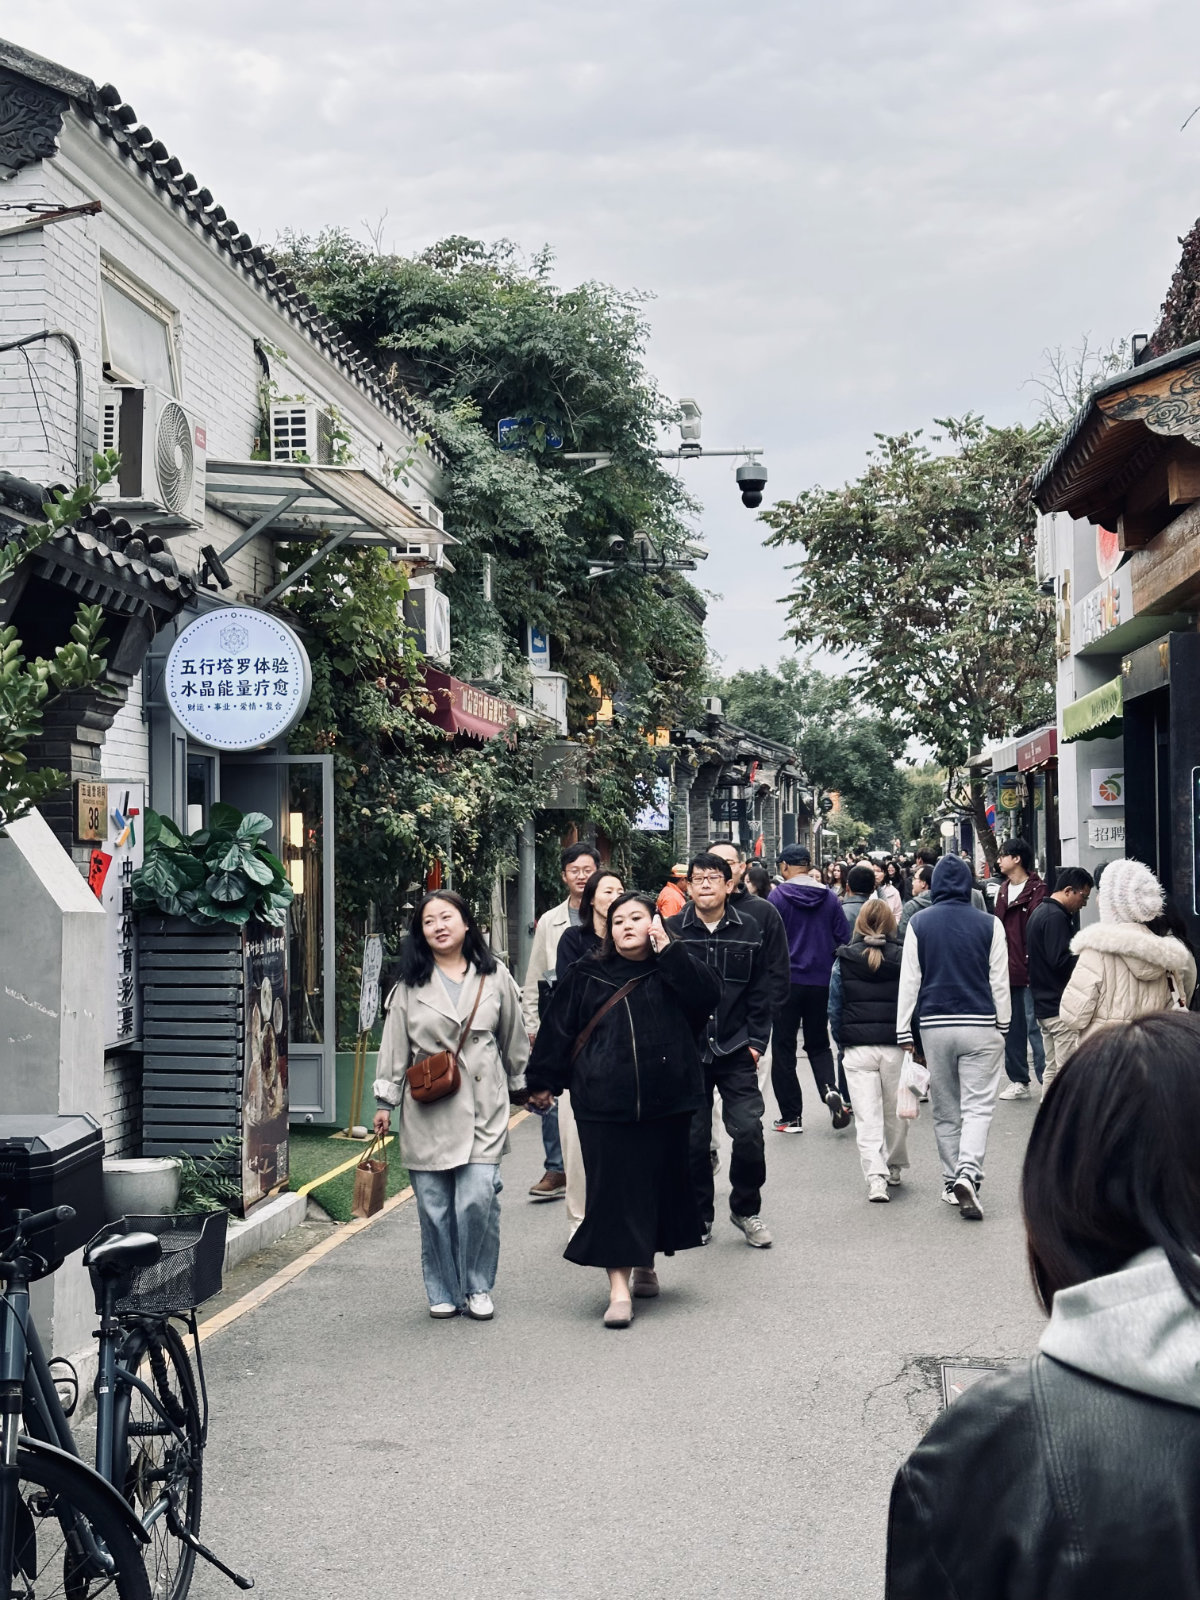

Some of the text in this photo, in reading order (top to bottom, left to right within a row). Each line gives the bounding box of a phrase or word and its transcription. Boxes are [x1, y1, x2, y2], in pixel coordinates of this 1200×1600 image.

[180, 657, 289, 675] 五行塔罗体验
[180, 679, 288, 697] 水晶能量疗愈
[721, 801, 738, 812] 42
[88, 806, 99, 830] 38
[1095, 826, 1125, 842] 招聘
[120, 855, 134, 1034] 中国体育彩票
